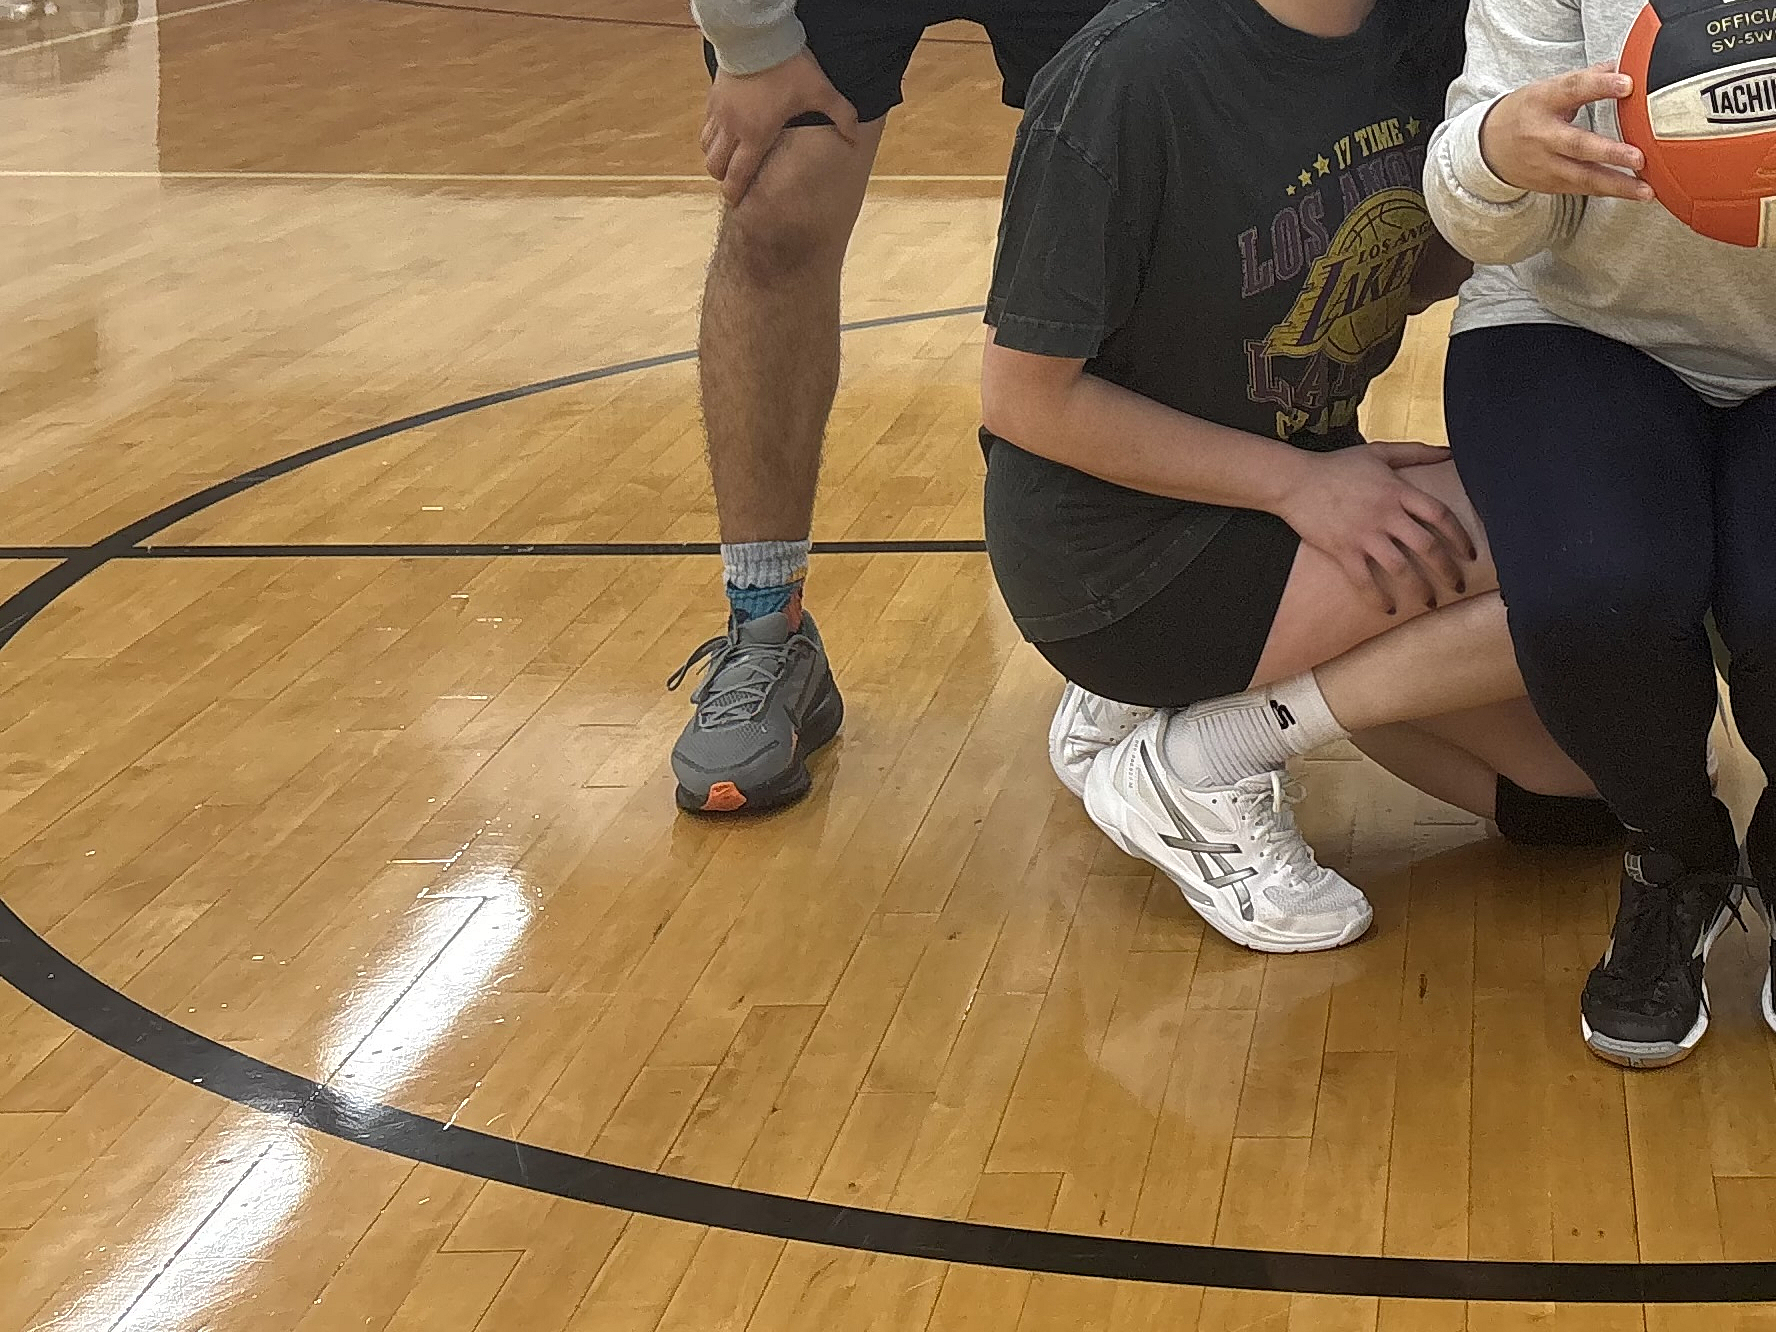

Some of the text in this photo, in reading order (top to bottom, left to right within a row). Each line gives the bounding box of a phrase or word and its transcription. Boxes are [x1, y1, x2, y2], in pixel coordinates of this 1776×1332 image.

[1333, 117, 1404, 170] 17 TIME
[1238, 190, 1330, 299] LOS
[1357, 238, 1391, 265] LOS
